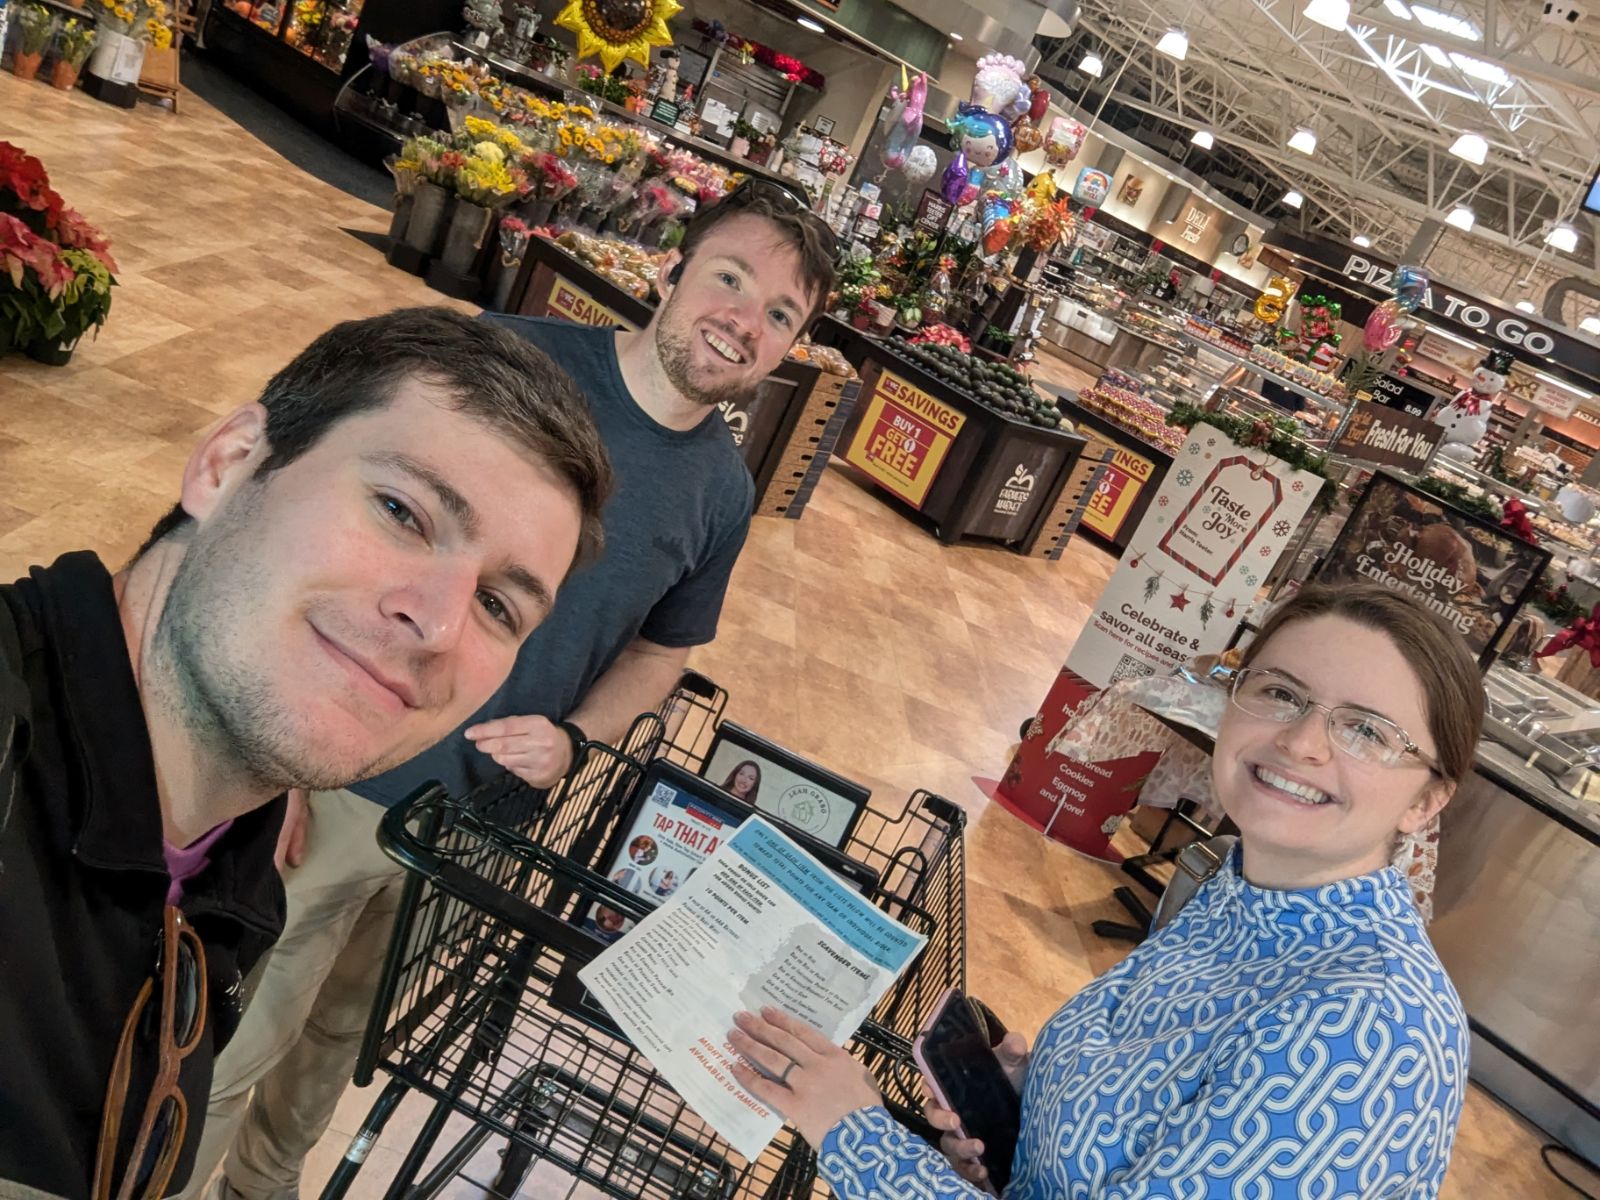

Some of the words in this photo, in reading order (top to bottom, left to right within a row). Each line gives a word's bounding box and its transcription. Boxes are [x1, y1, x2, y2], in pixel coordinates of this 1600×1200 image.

[1442, 294, 1490, 333] TO
[1495, 319, 1555, 355] GO
[1371, 374, 1404, 396] Salad
[1371, 389, 1391, 404] Bar
[895, 384, 960, 430] SAVINGS
[1403, 404, 1422, 417] 8.99
[883, 426, 907, 448] GET
[891, 414, 915, 435] BUY
[912, 427, 921, 438] 1
[1363, 419, 1398, 450] Fresh
[1391, 427, 1414, 454] For
[1408, 432, 1433, 460] You
[869, 434, 918, 476] FREE
[1210, 484, 1251, 521] Taste
[1201, 510, 1236, 539] Joy
[1224, 512, 1247, 533] More
[1177, 529, 1196, 544] Harris
[1194, 540, 1214, 555] Teeter
[1384, 540, 1469, 594] Holiday
[1354, 552, 1477, 634] Entertaining
[1093, 620, 1109, 633] Scan
[1108, 628, 1124, 642] here
[1122, 637, 1135, 648] for
[1133, 644, 1160, 663] recipes
[1098, 610, 1136, 636] savor
[1133, 629, 1155, 647] all
[1155, 641, 1191, 665] seas
[1119, 601, 1189, 646] Celebrate
[1189, 637, 1201, 651] &
[1051, 775, 1086, 802] Eggnog
[1058, 762, 1095, 787] Cookies
[788, 788, 807, 798] LEAH
[809, 790, 826, 813] GRABO
[1038, 788, 1058, 802] and
[650, 812, 675, 834] TAP
[670, 819, 708, 852] THAT
[736, 863, 759, 881] BONUS
[755, 877, 770, 890] LIST
[711, 892, 728, 907] POINTS
[726, 904, 738, 915] PER
[735, 912, 750, 925] ITEM
[816, 939, 851, 968] SCAVENGER
[849, 963, 871, 982] ITEMS
[697, 1035, 722, 1060] MIGHT
[720, 1057, 735, 1073] NO
[722, 1040, 738, 1056] CAN
[688, 1045, 725, 1083] AVAILABLE
[723, 1080, 735, 1092] TO
[733, 1089, 768, 1118] FAMILIES
